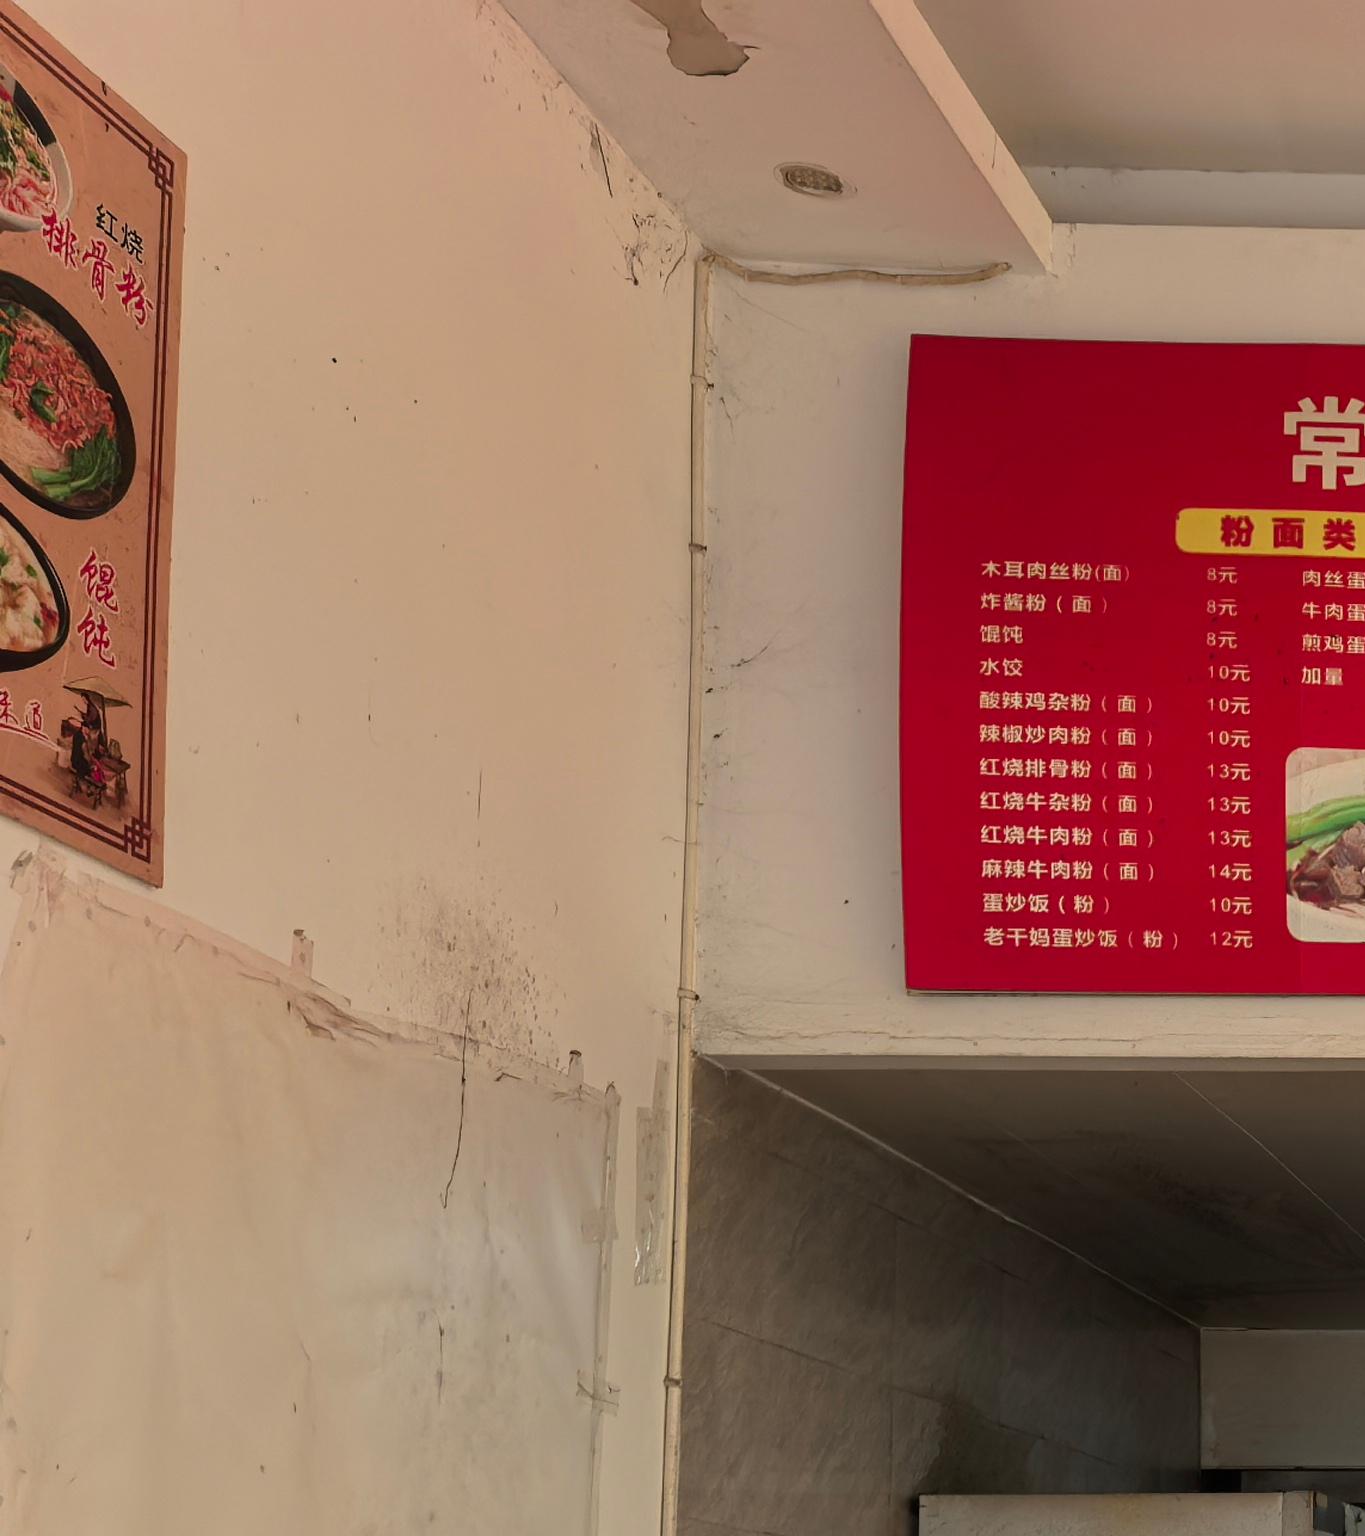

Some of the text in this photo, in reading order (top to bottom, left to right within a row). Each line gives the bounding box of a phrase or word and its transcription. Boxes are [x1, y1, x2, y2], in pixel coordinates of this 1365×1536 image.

[96, 203, 144, 264] 红烧
[40, 207, 155, 326] 排骨粉
[1220, 514, 1357, 551] 粉面类
[1207, 566, 1238, 584] 8元
[77, 550, 120, 669] 馄饨
[1206, 598, 1238, 617] 8元
[979, 624, 1238, 649] 馄饨 8元
[979, 657, 1251, 683] 水饺 10元
[1301, 666, 1343, 686] 加量
[1208, 696, 1251, 715] 10元
[1207, 729, 1251, 749] 10元
[1207, 763, 1251, 782] 13元
[1207, 796, 1251, 815] 13元
[1208, 829, 1252, 849] 13元
[1208, 862, 1252, 882] 14元
[1210, 896, 1253, 915] 10元
[1210, 930, 1253, 949] 12元
